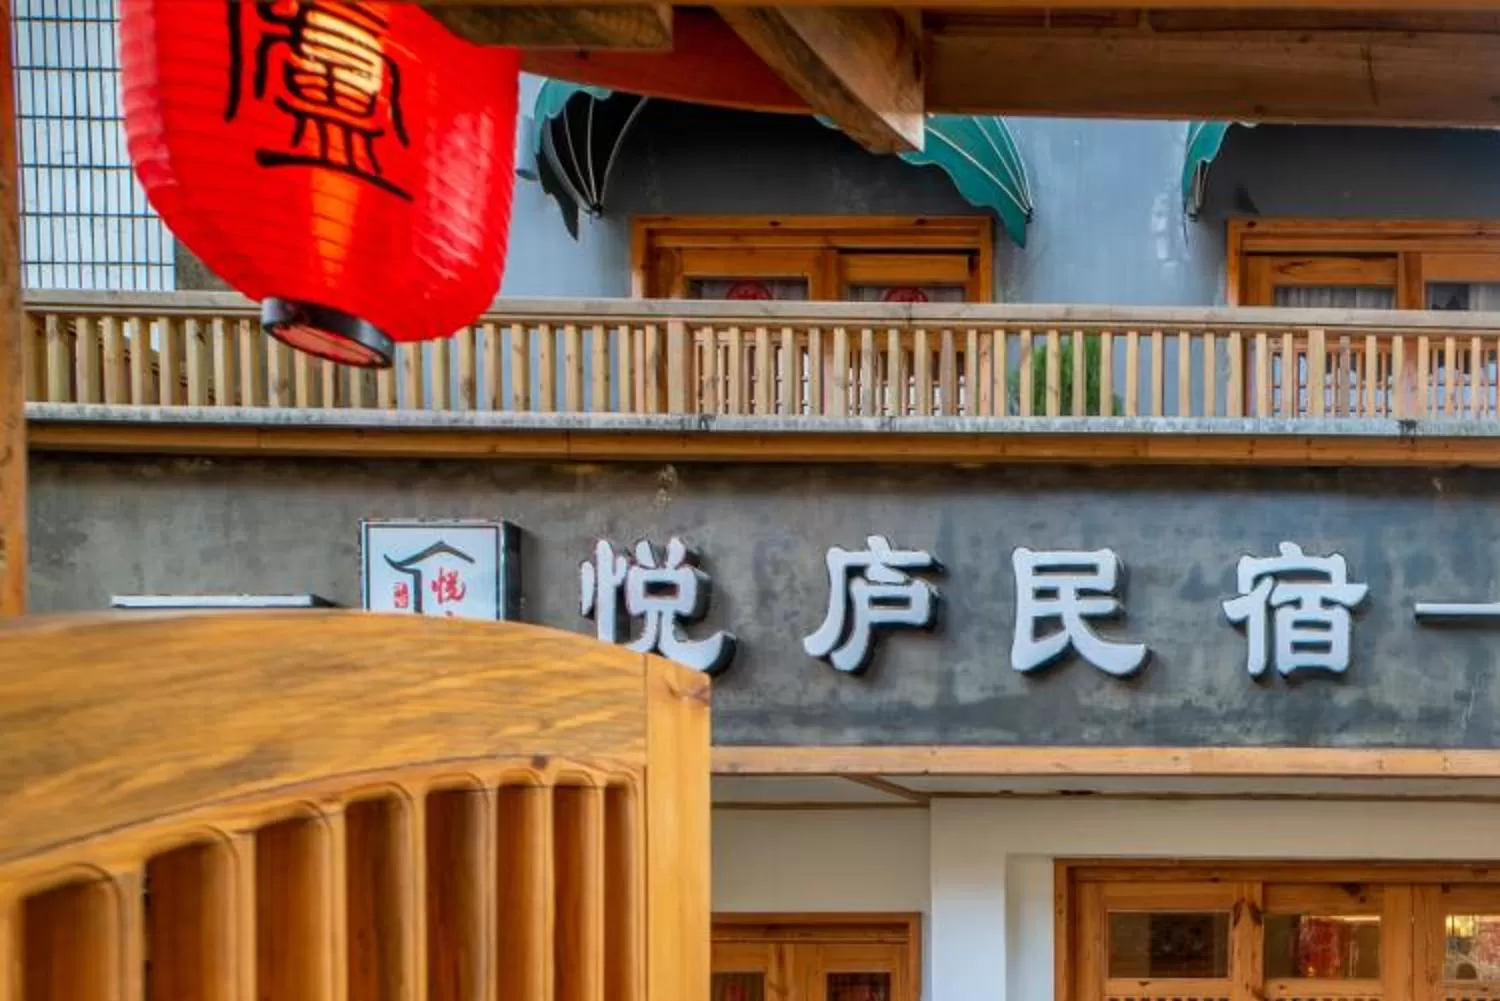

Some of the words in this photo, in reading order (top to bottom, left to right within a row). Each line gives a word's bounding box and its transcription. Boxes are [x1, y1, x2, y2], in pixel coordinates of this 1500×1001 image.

[431, 566, 466, 616] 悦
[580, 535, 1368, 677] 悦庐民宿
